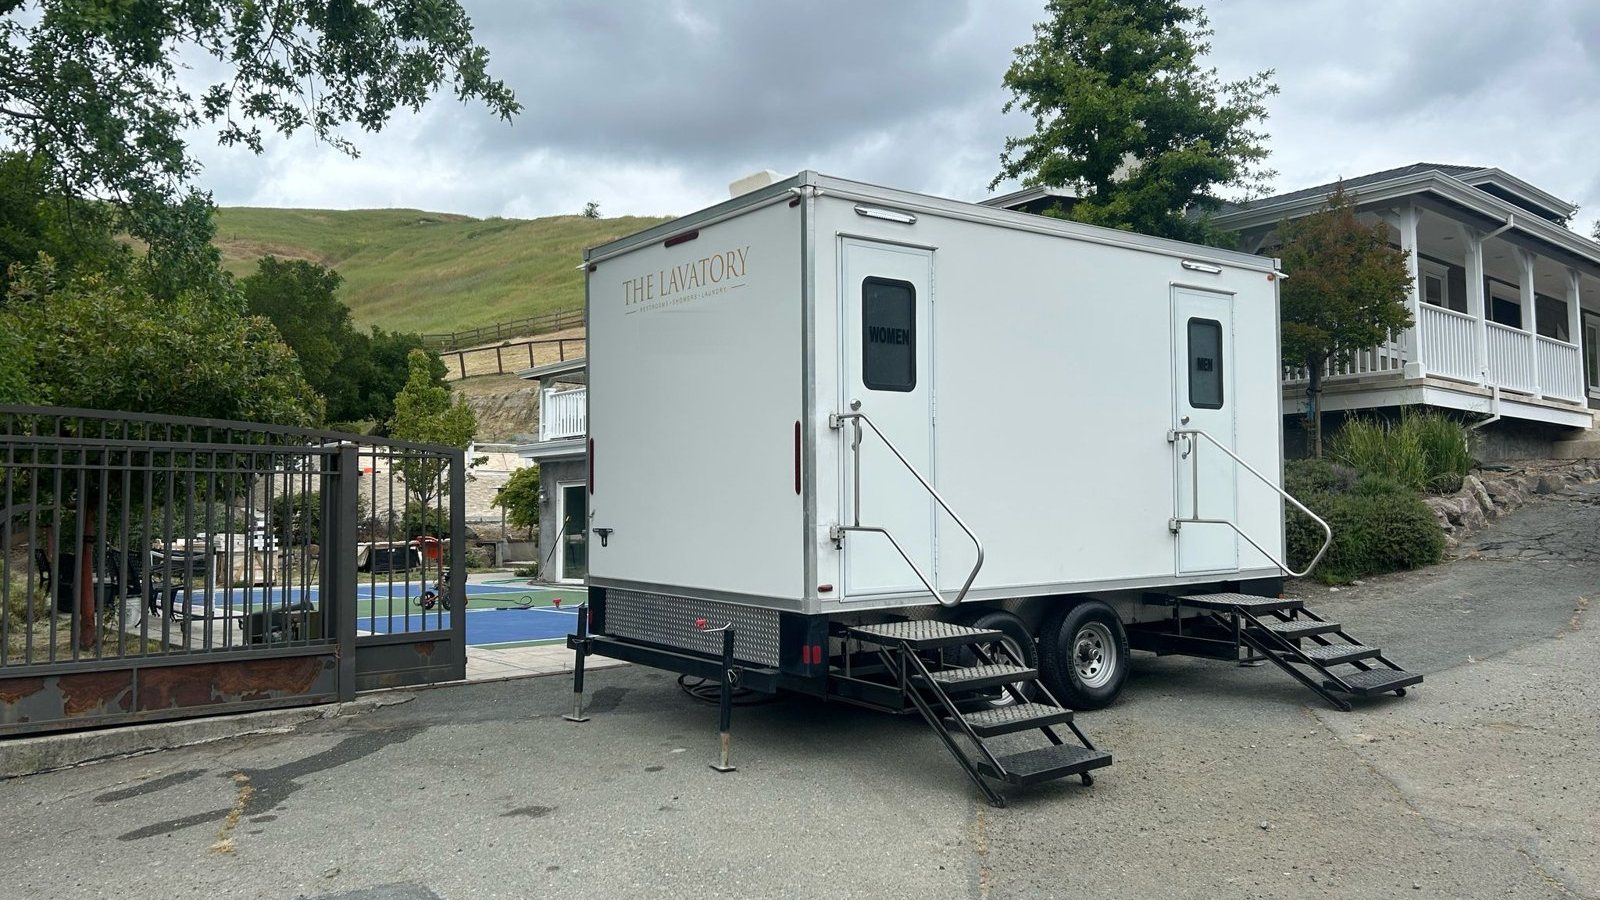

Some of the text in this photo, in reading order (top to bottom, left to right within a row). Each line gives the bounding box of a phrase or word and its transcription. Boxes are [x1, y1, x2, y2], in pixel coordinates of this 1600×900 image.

[622, 246, 750, 305] THE LAVATORY
[869, 326, 909, 346] WOMEN
[1197, 357, 1213, 372] MEN
